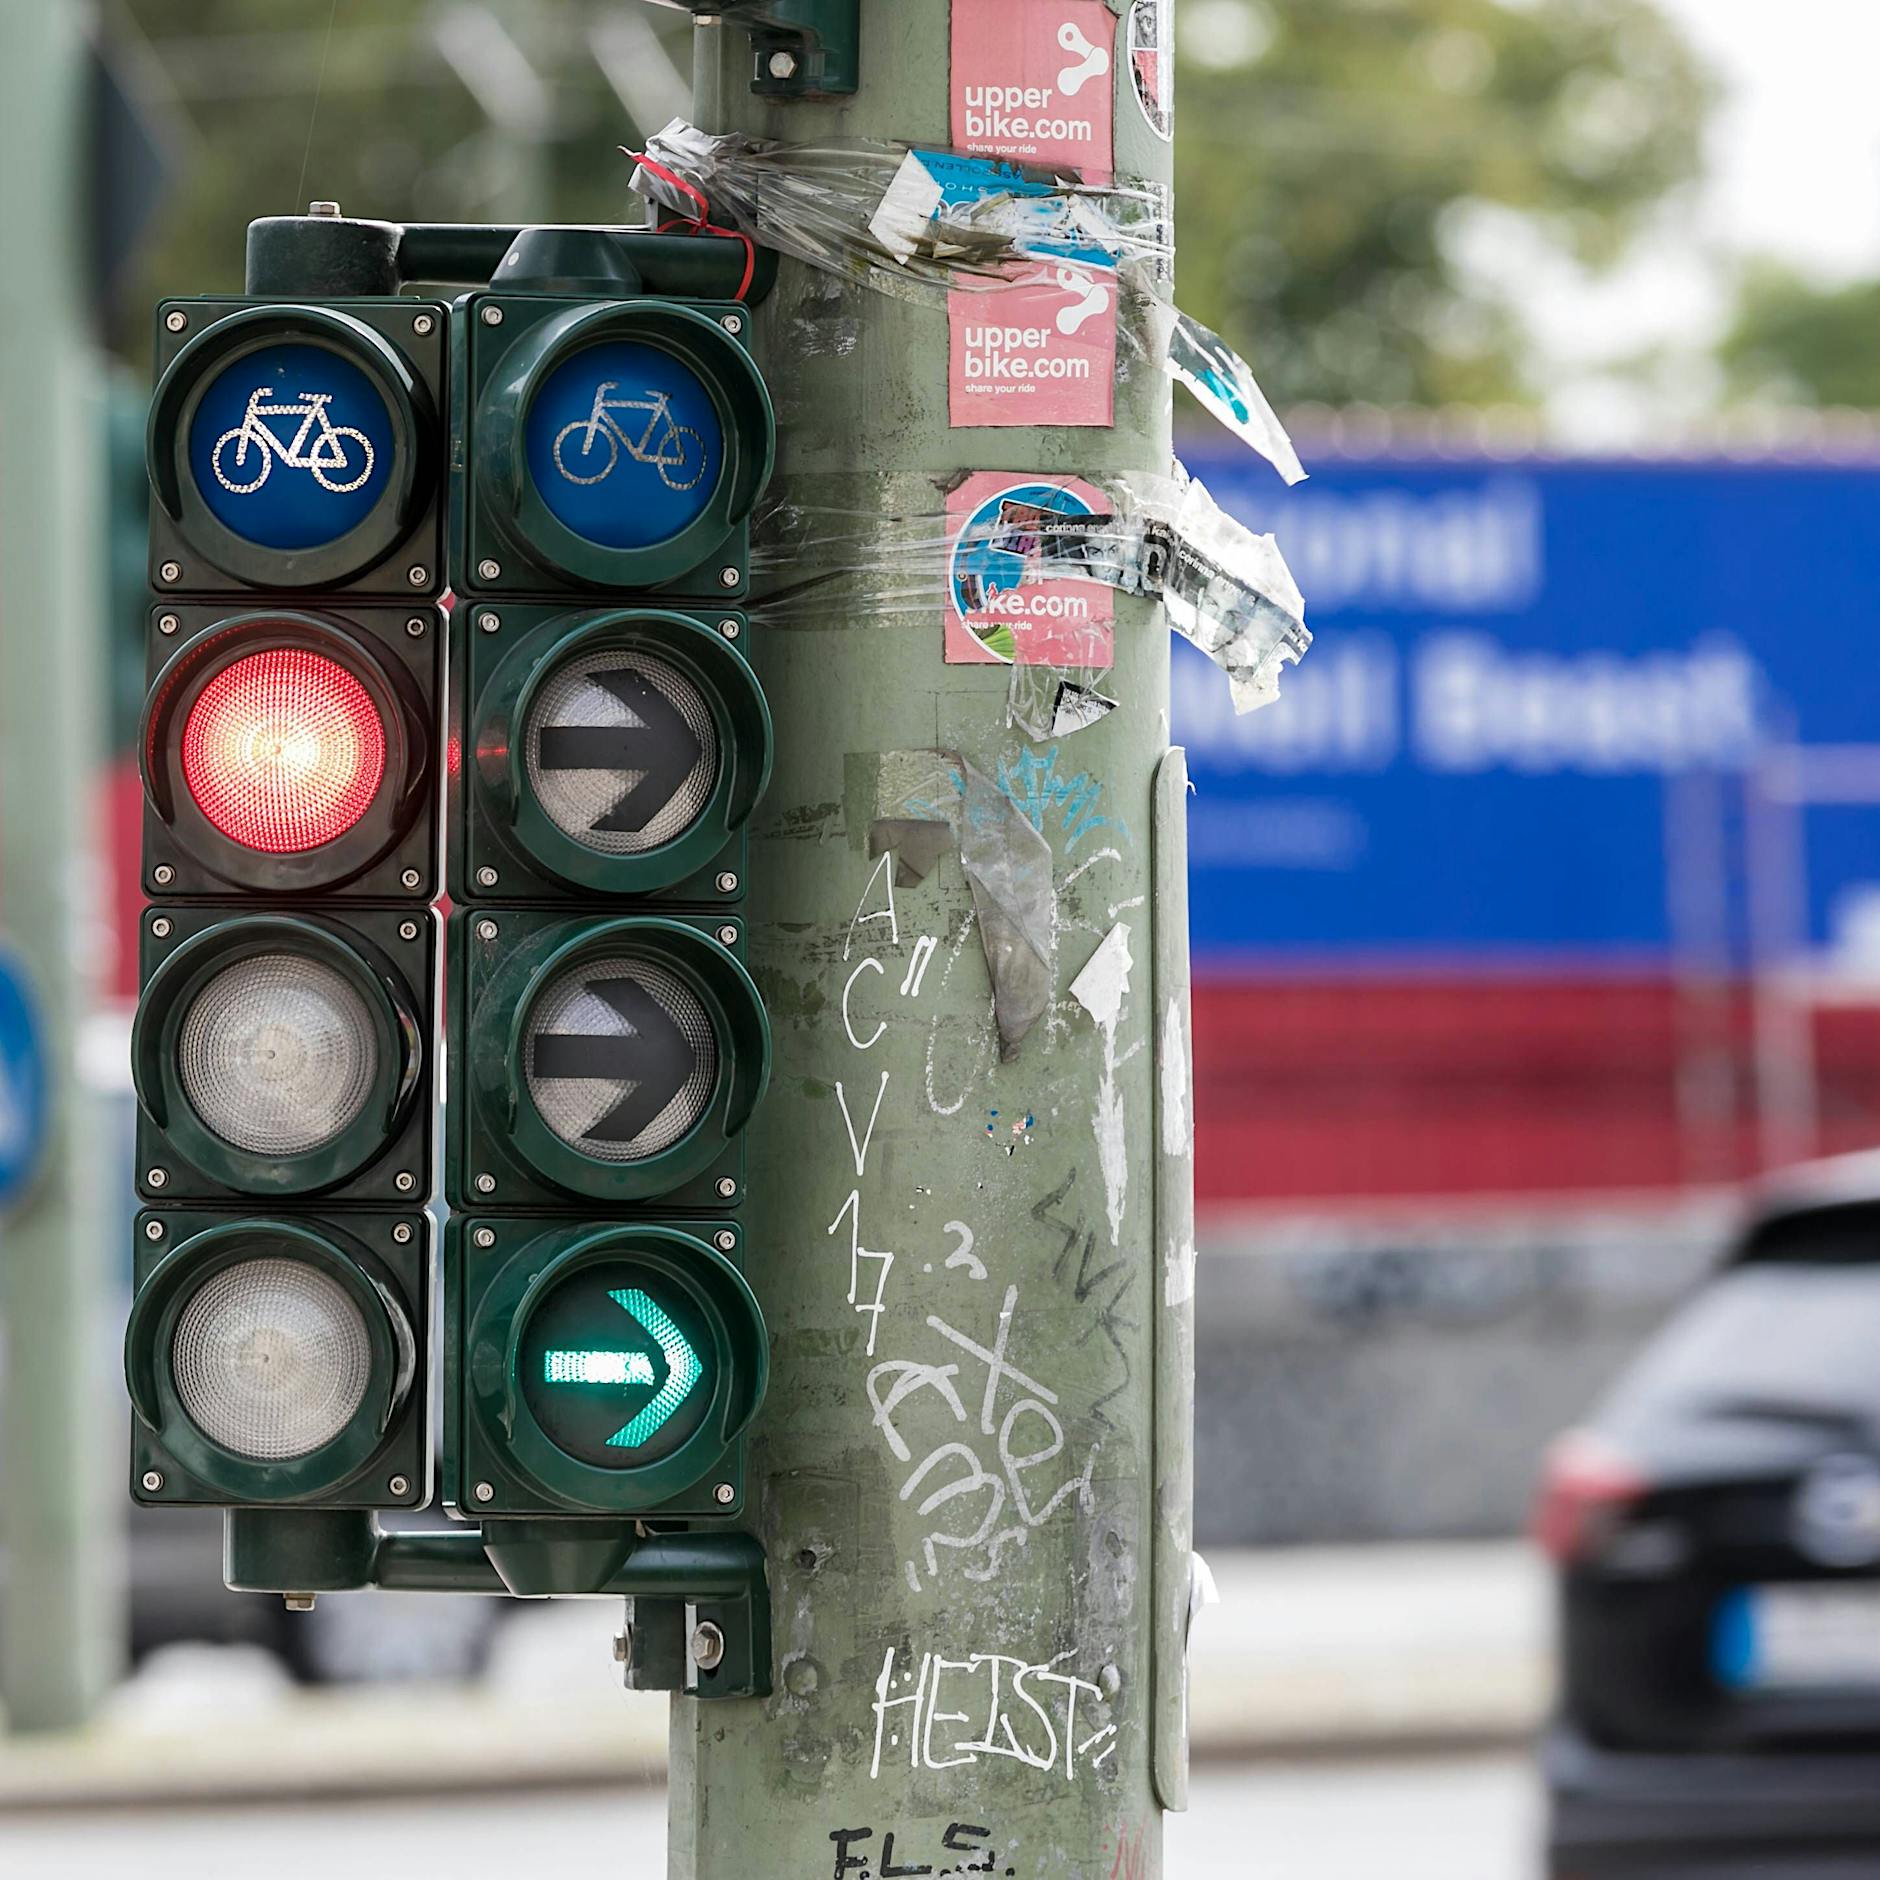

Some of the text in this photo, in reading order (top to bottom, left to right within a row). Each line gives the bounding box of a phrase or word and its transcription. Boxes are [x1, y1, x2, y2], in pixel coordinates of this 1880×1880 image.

[965, 86, 1053, 116] upper
[965, 109, 1092, 140] bike.com
[966, 142, 1037, 154] share your ride
[965, 327, 1051, 356] upper
[965, 351, 1089, 378] bike.com
[965, 384, 1036, 395] share your ride
[1178, 550, 1215, 579] corinna
[1015, 621, 1032, 631] ride
